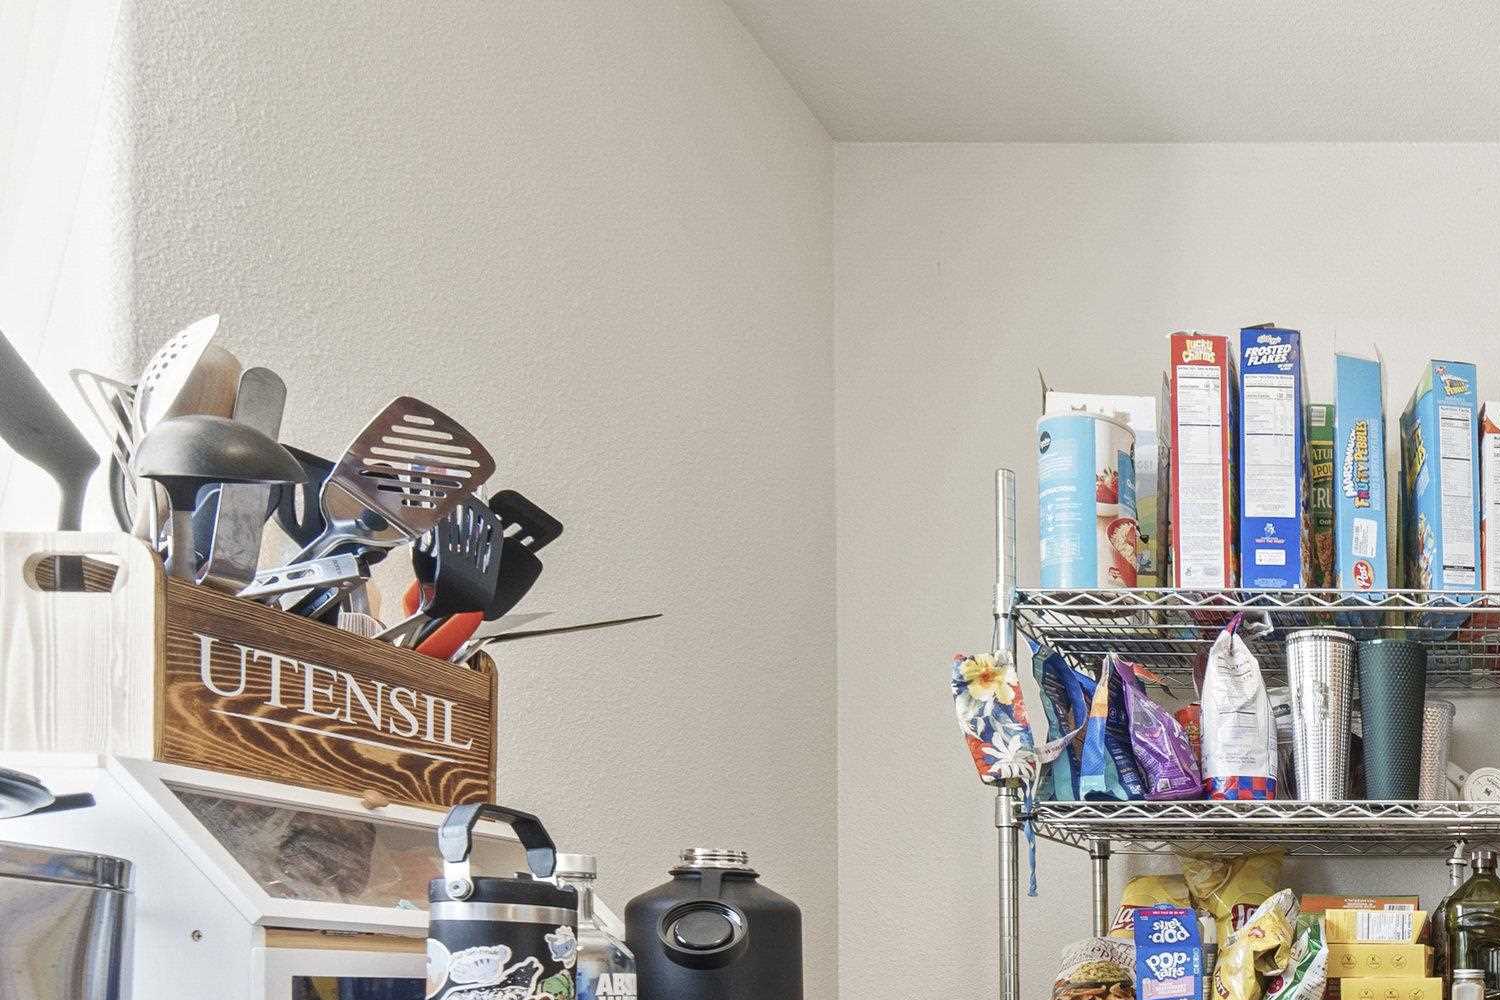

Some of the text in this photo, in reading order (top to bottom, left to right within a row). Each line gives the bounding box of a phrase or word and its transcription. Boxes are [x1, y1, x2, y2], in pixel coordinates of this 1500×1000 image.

[1244, 344, 1292, 358] FROSTED
[1247, 355, 1289, 366] FLAKES
[1355, 562, 1372, 591] Post
[194, 633, 473, 751] UTENSIL
